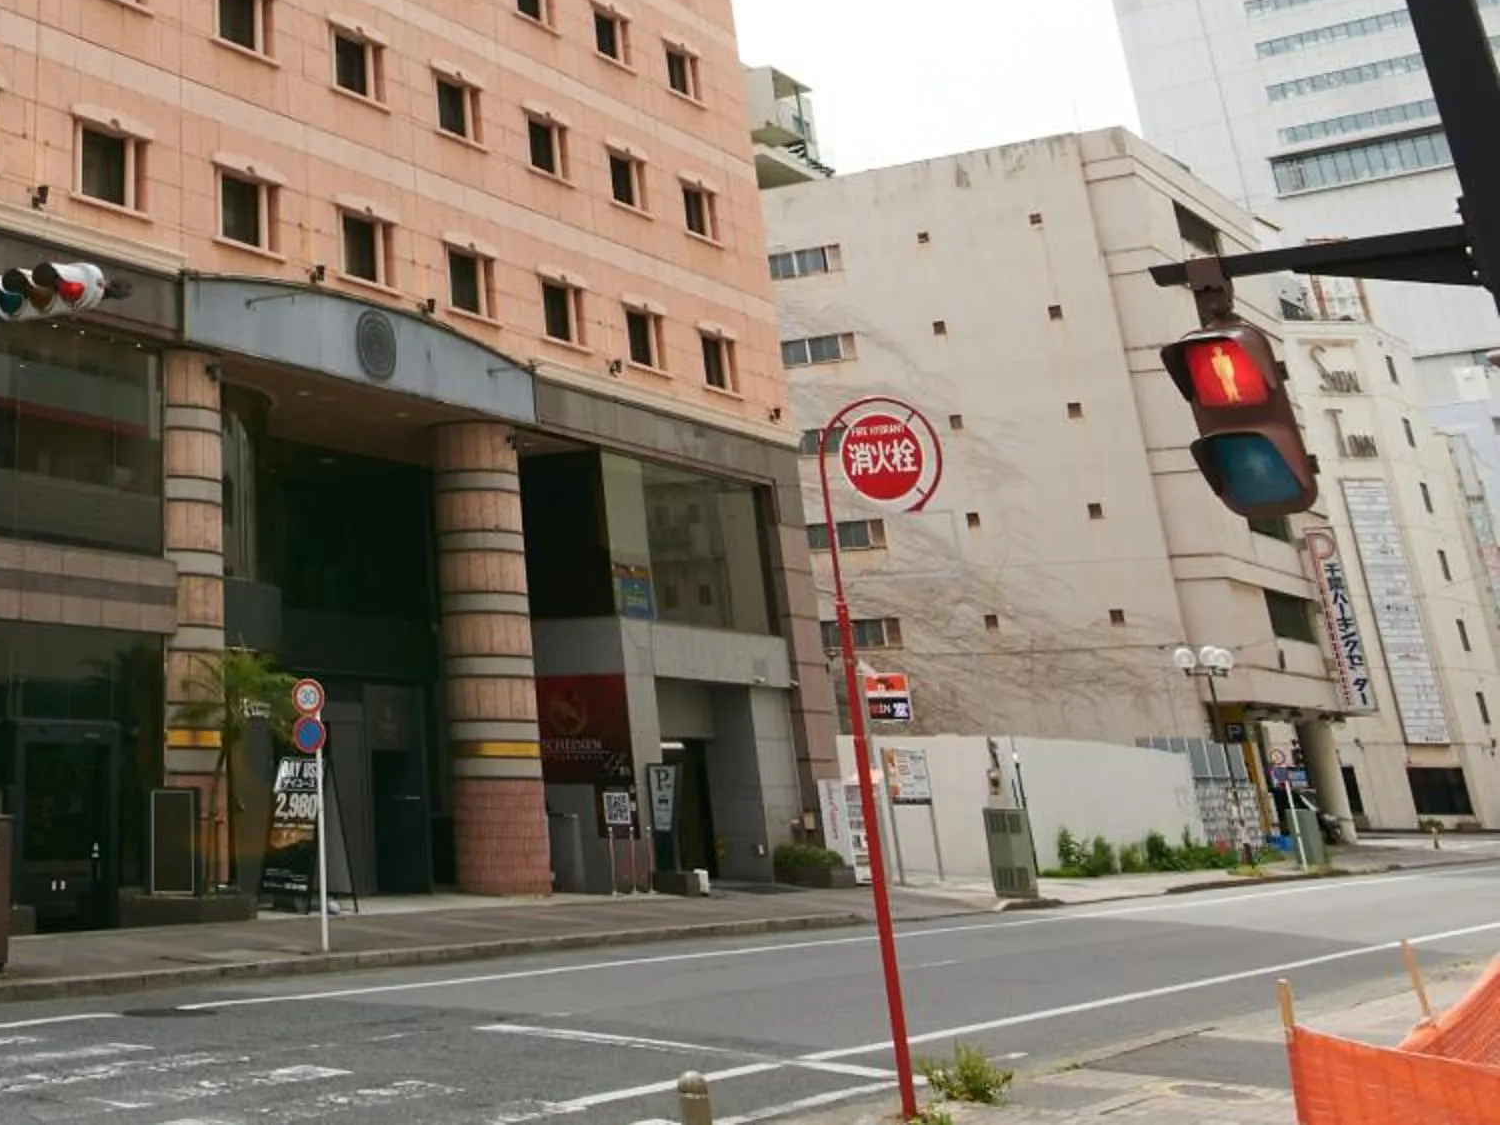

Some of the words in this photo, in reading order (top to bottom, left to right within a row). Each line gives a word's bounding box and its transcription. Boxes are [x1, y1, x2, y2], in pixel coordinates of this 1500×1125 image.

[847, 438, 919, 475] 消火栓
[655, 769, 669, 791] P
[274, 792, 318, 820] 2,980
